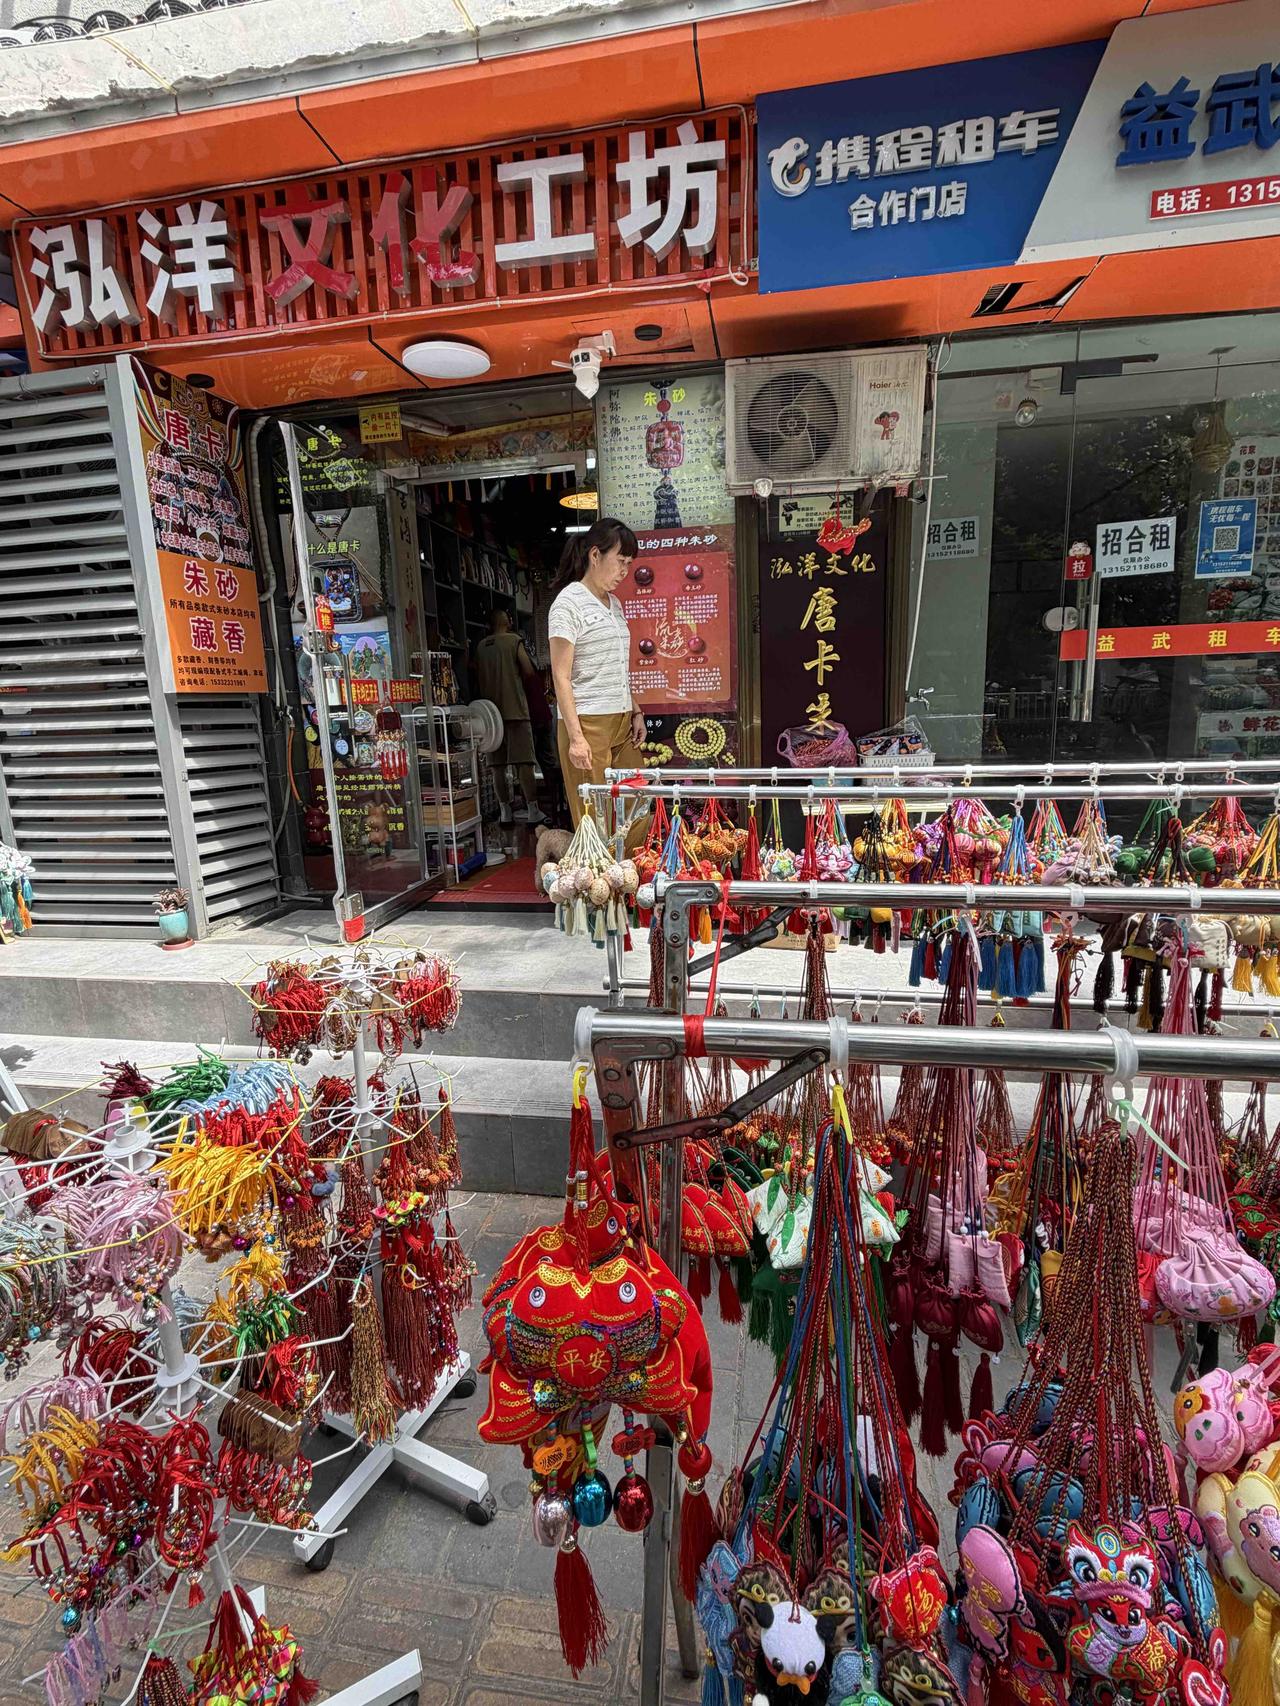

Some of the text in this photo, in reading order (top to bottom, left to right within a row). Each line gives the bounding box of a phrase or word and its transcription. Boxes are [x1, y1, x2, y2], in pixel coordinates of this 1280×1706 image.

[1116, 62, 1280, 168] 益武
[815, 108, 1060, 187] 携程租车
[848, 181, 969, 231] 合作门店
[30, 119, 729, 334] 泓洋文化工坊
[643, 387, 686, 407] 朱砂
[870, 381, 891, 389] Haier
[609, 389, 622, 438] 阿弥陀佛
[164, 410, 223, 461] 唐卡
[927, 520, 976, 545] 招合租
[1102, 523, 1171, 556] 招合租
[184, 560, 239, 602] 朱砂
[770, 552, 876, 580] 泓洋文化
[1072, 559, 1086, 574] 拉
[1102, 561, 1169, 574] 13152118680
[190, 616, 245, 653] 藏香
[557, 1347, 610, 1378] 平安
